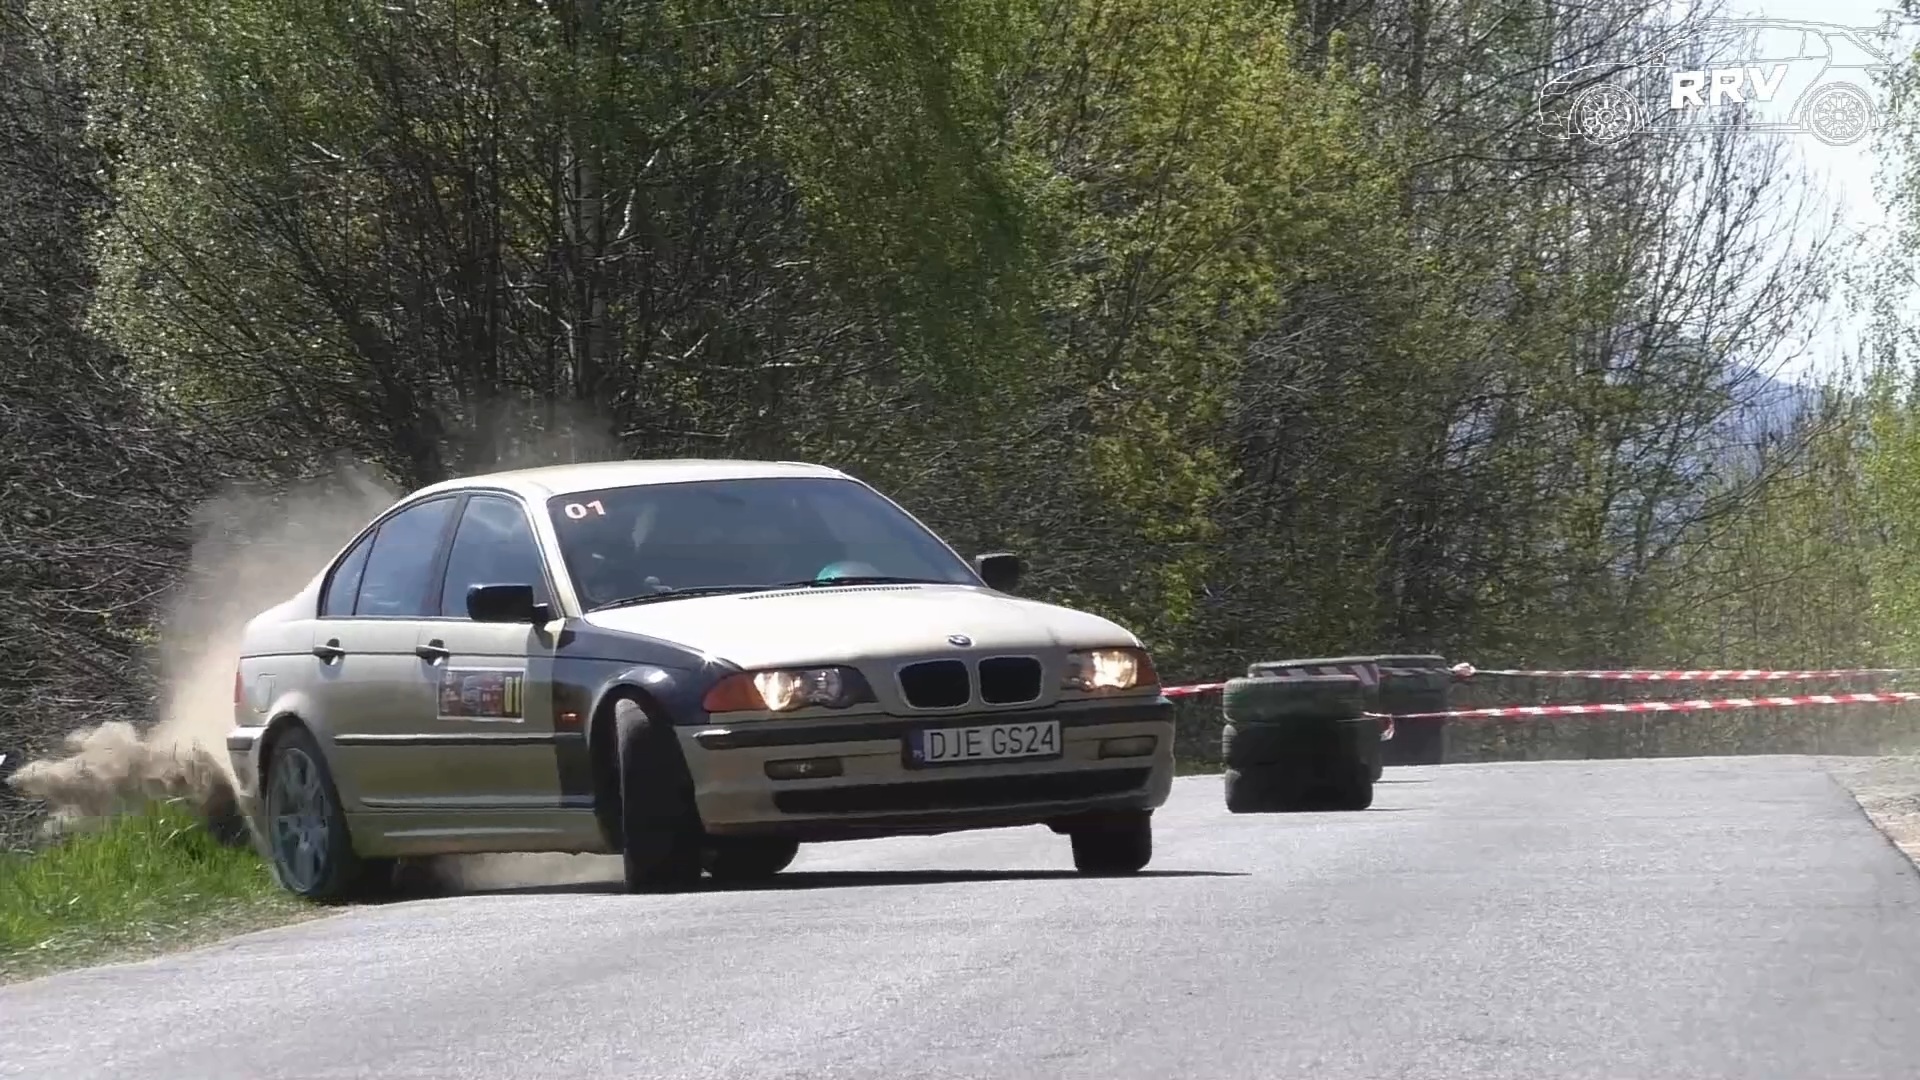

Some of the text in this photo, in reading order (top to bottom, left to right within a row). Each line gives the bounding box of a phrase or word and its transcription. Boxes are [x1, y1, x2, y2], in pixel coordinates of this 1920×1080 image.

[564, 500, 606, 519] 01
[930, 724, 1054, 759] DJE GS24
